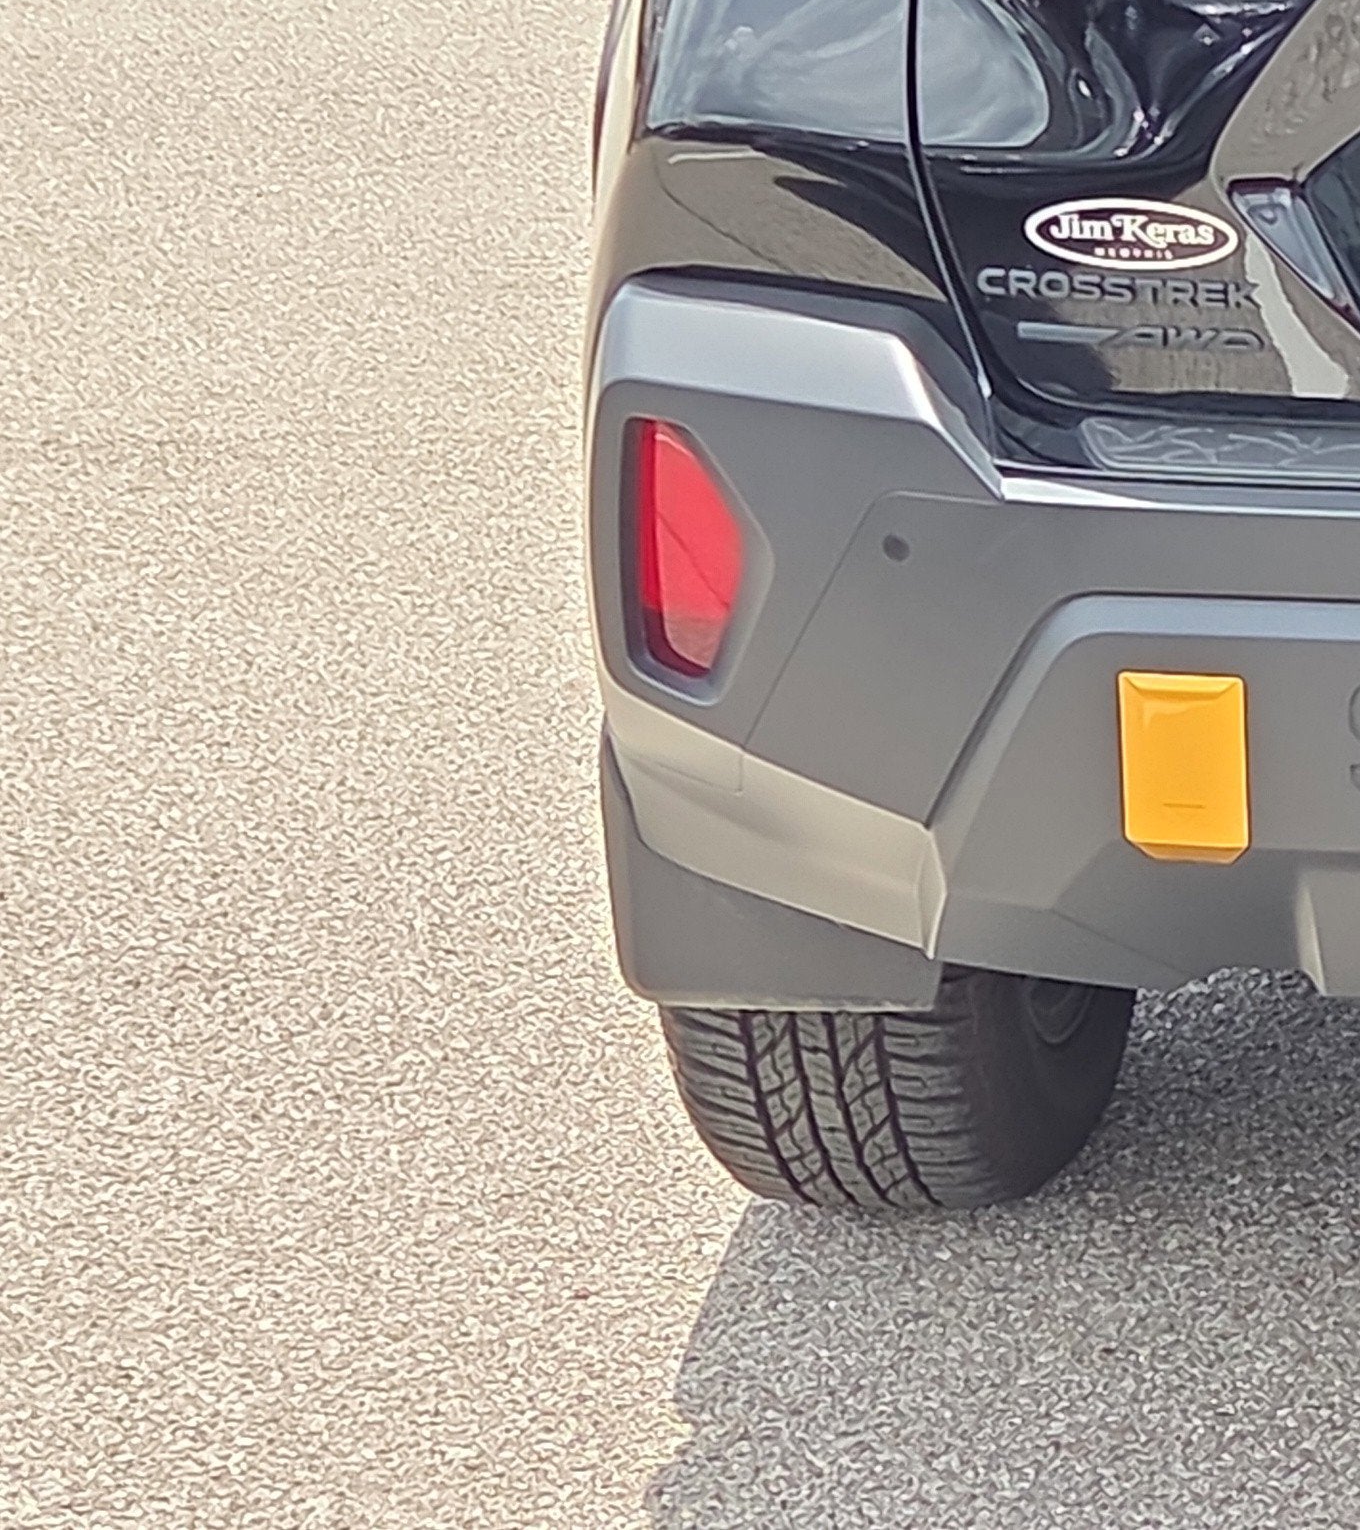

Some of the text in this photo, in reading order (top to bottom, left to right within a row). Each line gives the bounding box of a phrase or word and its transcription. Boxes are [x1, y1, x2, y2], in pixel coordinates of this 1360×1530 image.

[1050, 213, 1216, 249] Jim Keras
[976, 267, 1261, 310] CROSSTREK
[1103, 325, 1265, 350] AWD
